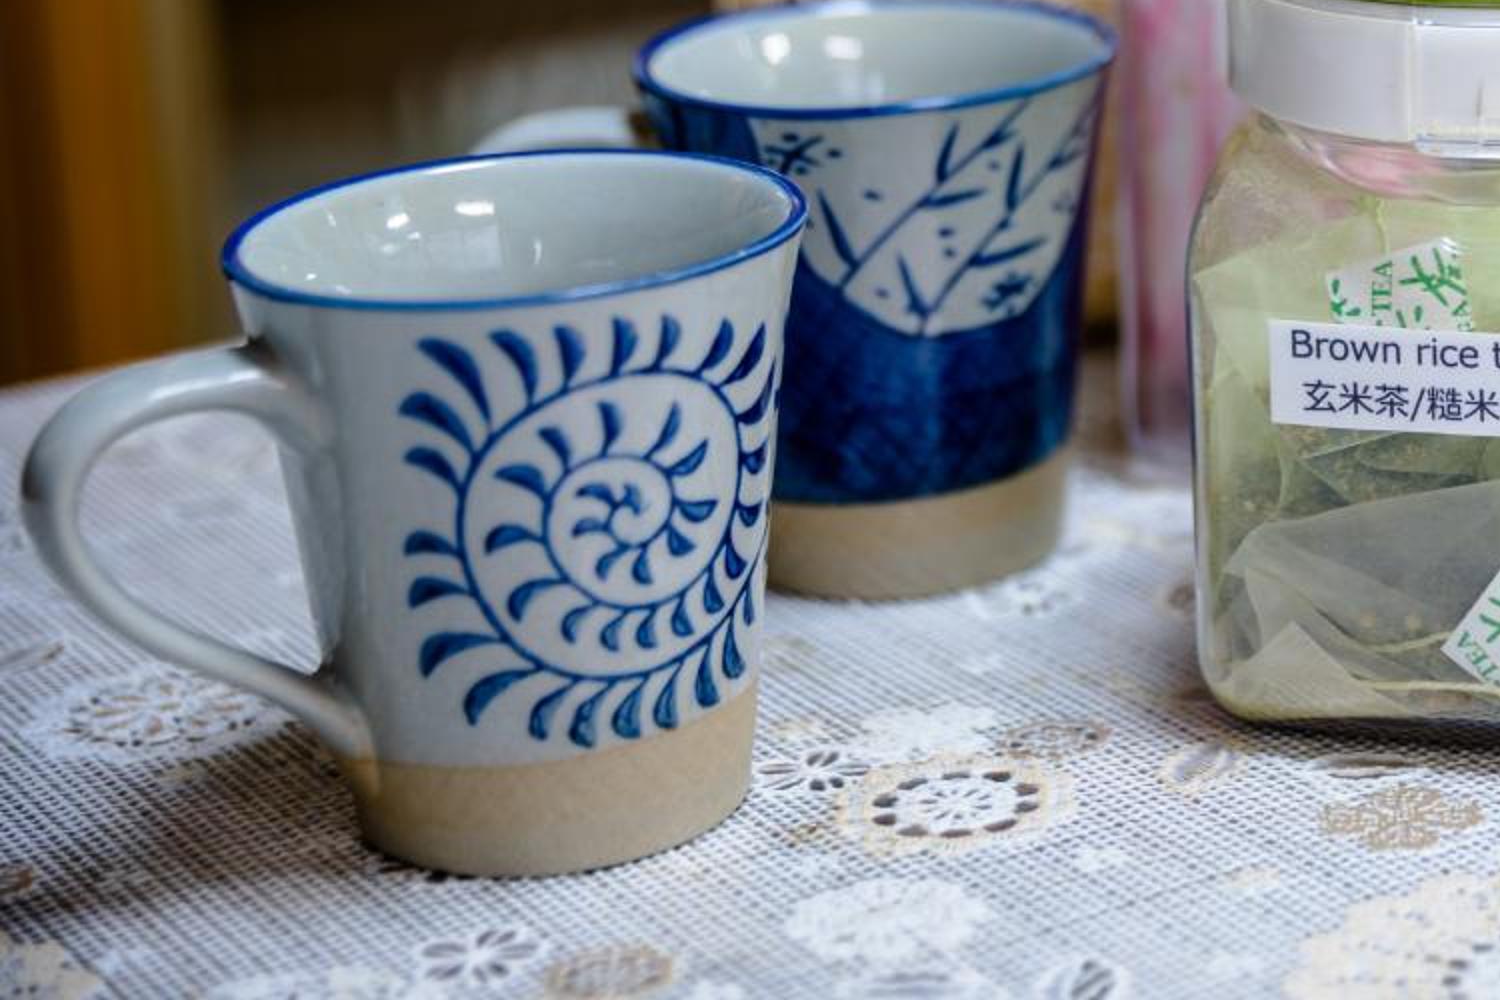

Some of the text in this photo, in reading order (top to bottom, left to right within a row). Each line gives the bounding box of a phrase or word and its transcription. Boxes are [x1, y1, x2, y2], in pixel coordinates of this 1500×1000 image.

[1290, 328, 1402, 365] Brown
[1417, 337, 1480, 369] rice
[1458, 632, 1499, 678] TEA
